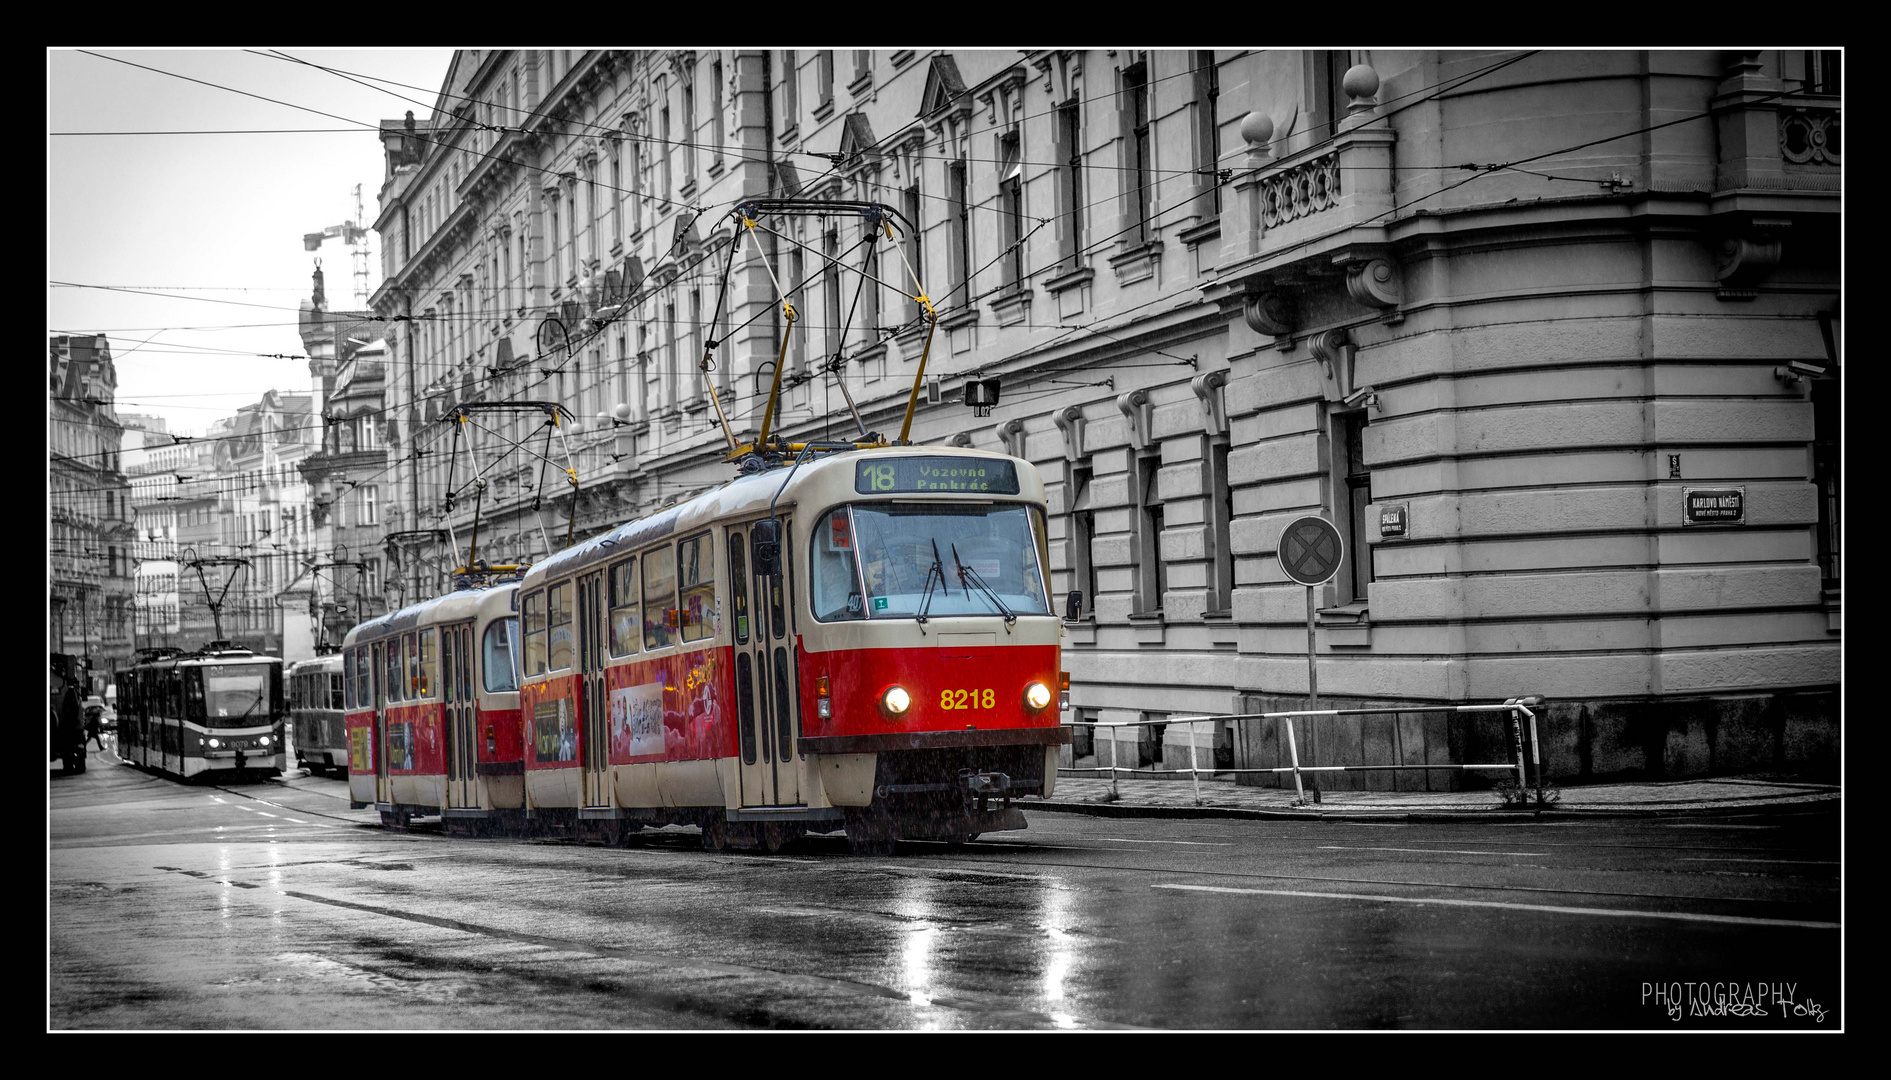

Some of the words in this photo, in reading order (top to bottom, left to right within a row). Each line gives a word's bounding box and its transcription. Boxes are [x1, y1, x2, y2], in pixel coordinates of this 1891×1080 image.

[863, 464, 895, 491] 18
[919, 465, 986, 477] Vozovna
[917, 479, 989, 491] Pankrác
[1692, 497, 1717, 508] KARLOVO
[1718, 495, 1739, 508] NÁMĚSTÍ
[1382, 511, 1399, 524] SPÁLENÁ
[940, 688, 996, 710] 8218
